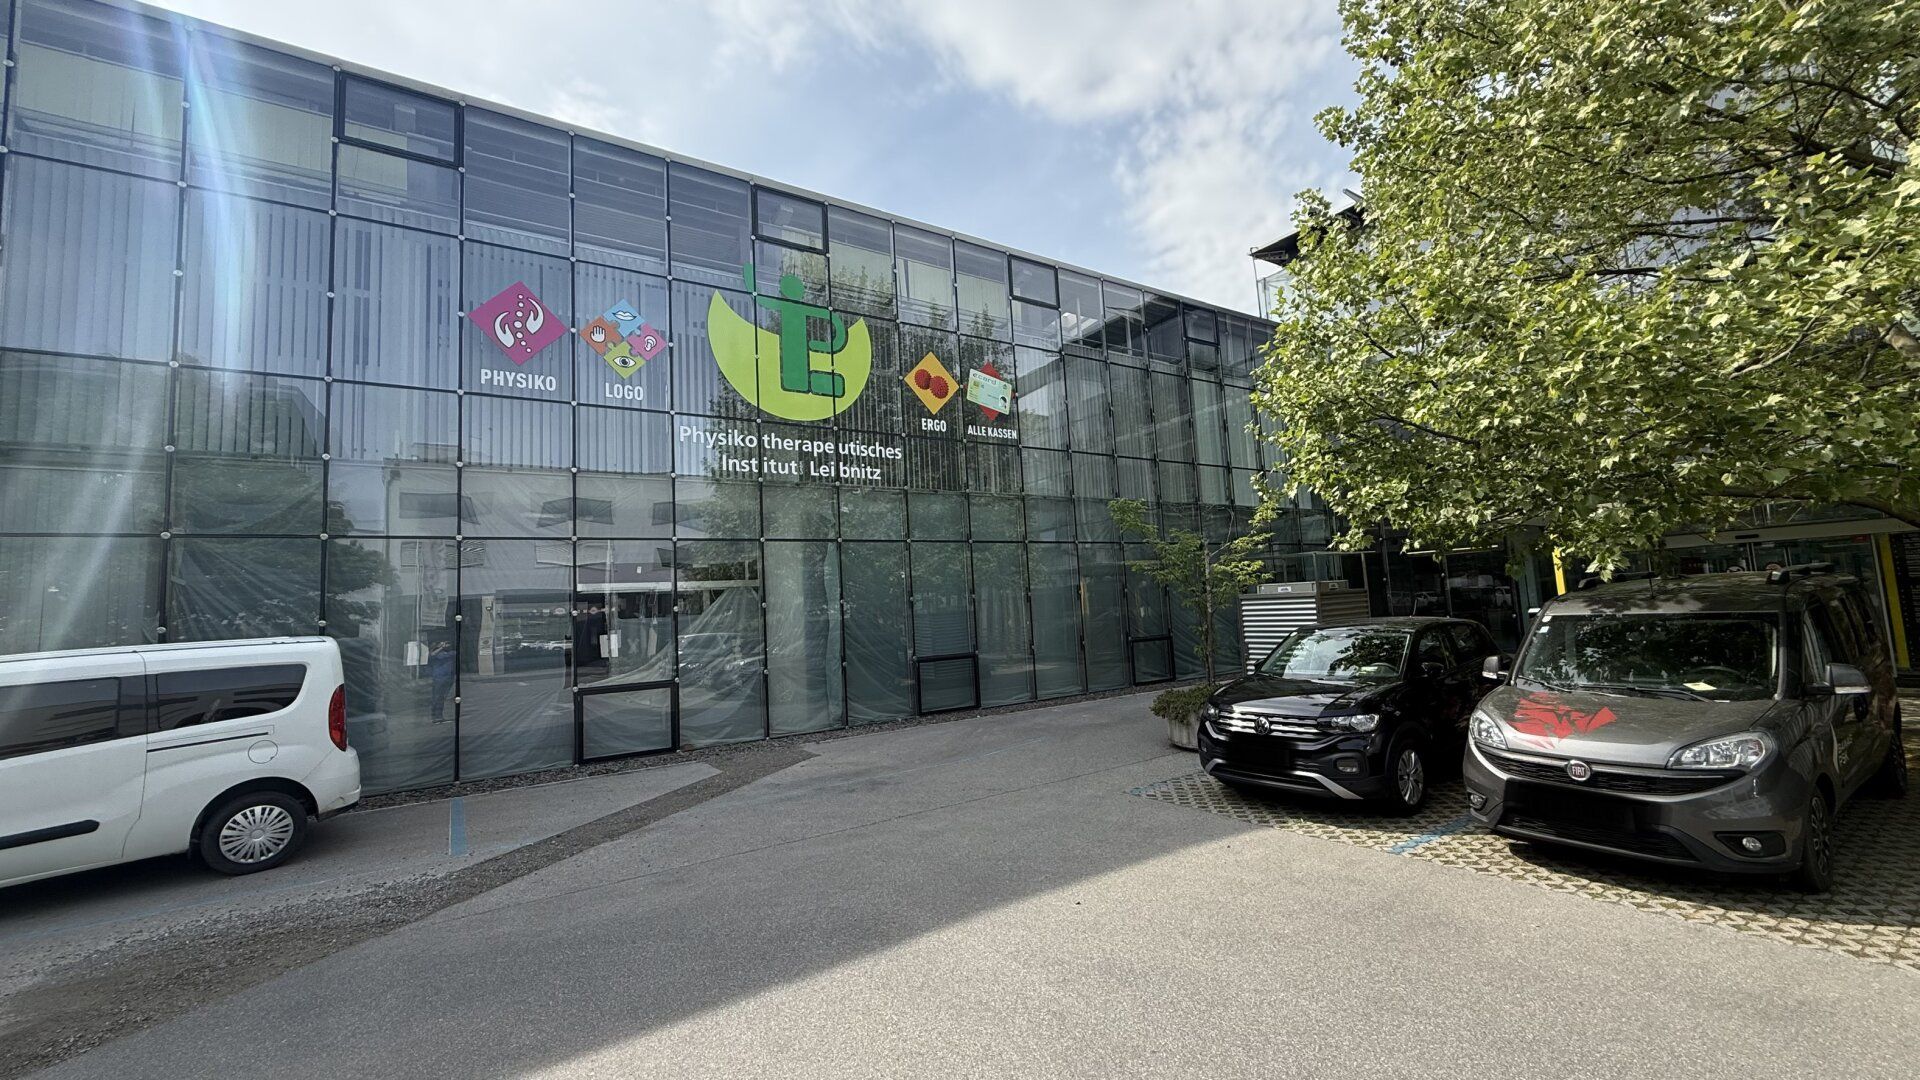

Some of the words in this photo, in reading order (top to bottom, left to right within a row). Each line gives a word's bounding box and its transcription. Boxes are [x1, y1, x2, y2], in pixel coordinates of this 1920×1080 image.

[480, 369, 556, 391] PHYSIKO
[605, 382, 644, 401] LOGO
[922, 418, 946, 432] ERGO
[967, 425, 986, 436] ALLE
[988, 428, 1017, 439] KASSEN
[1572, 766, 1585, 776] FIAT
